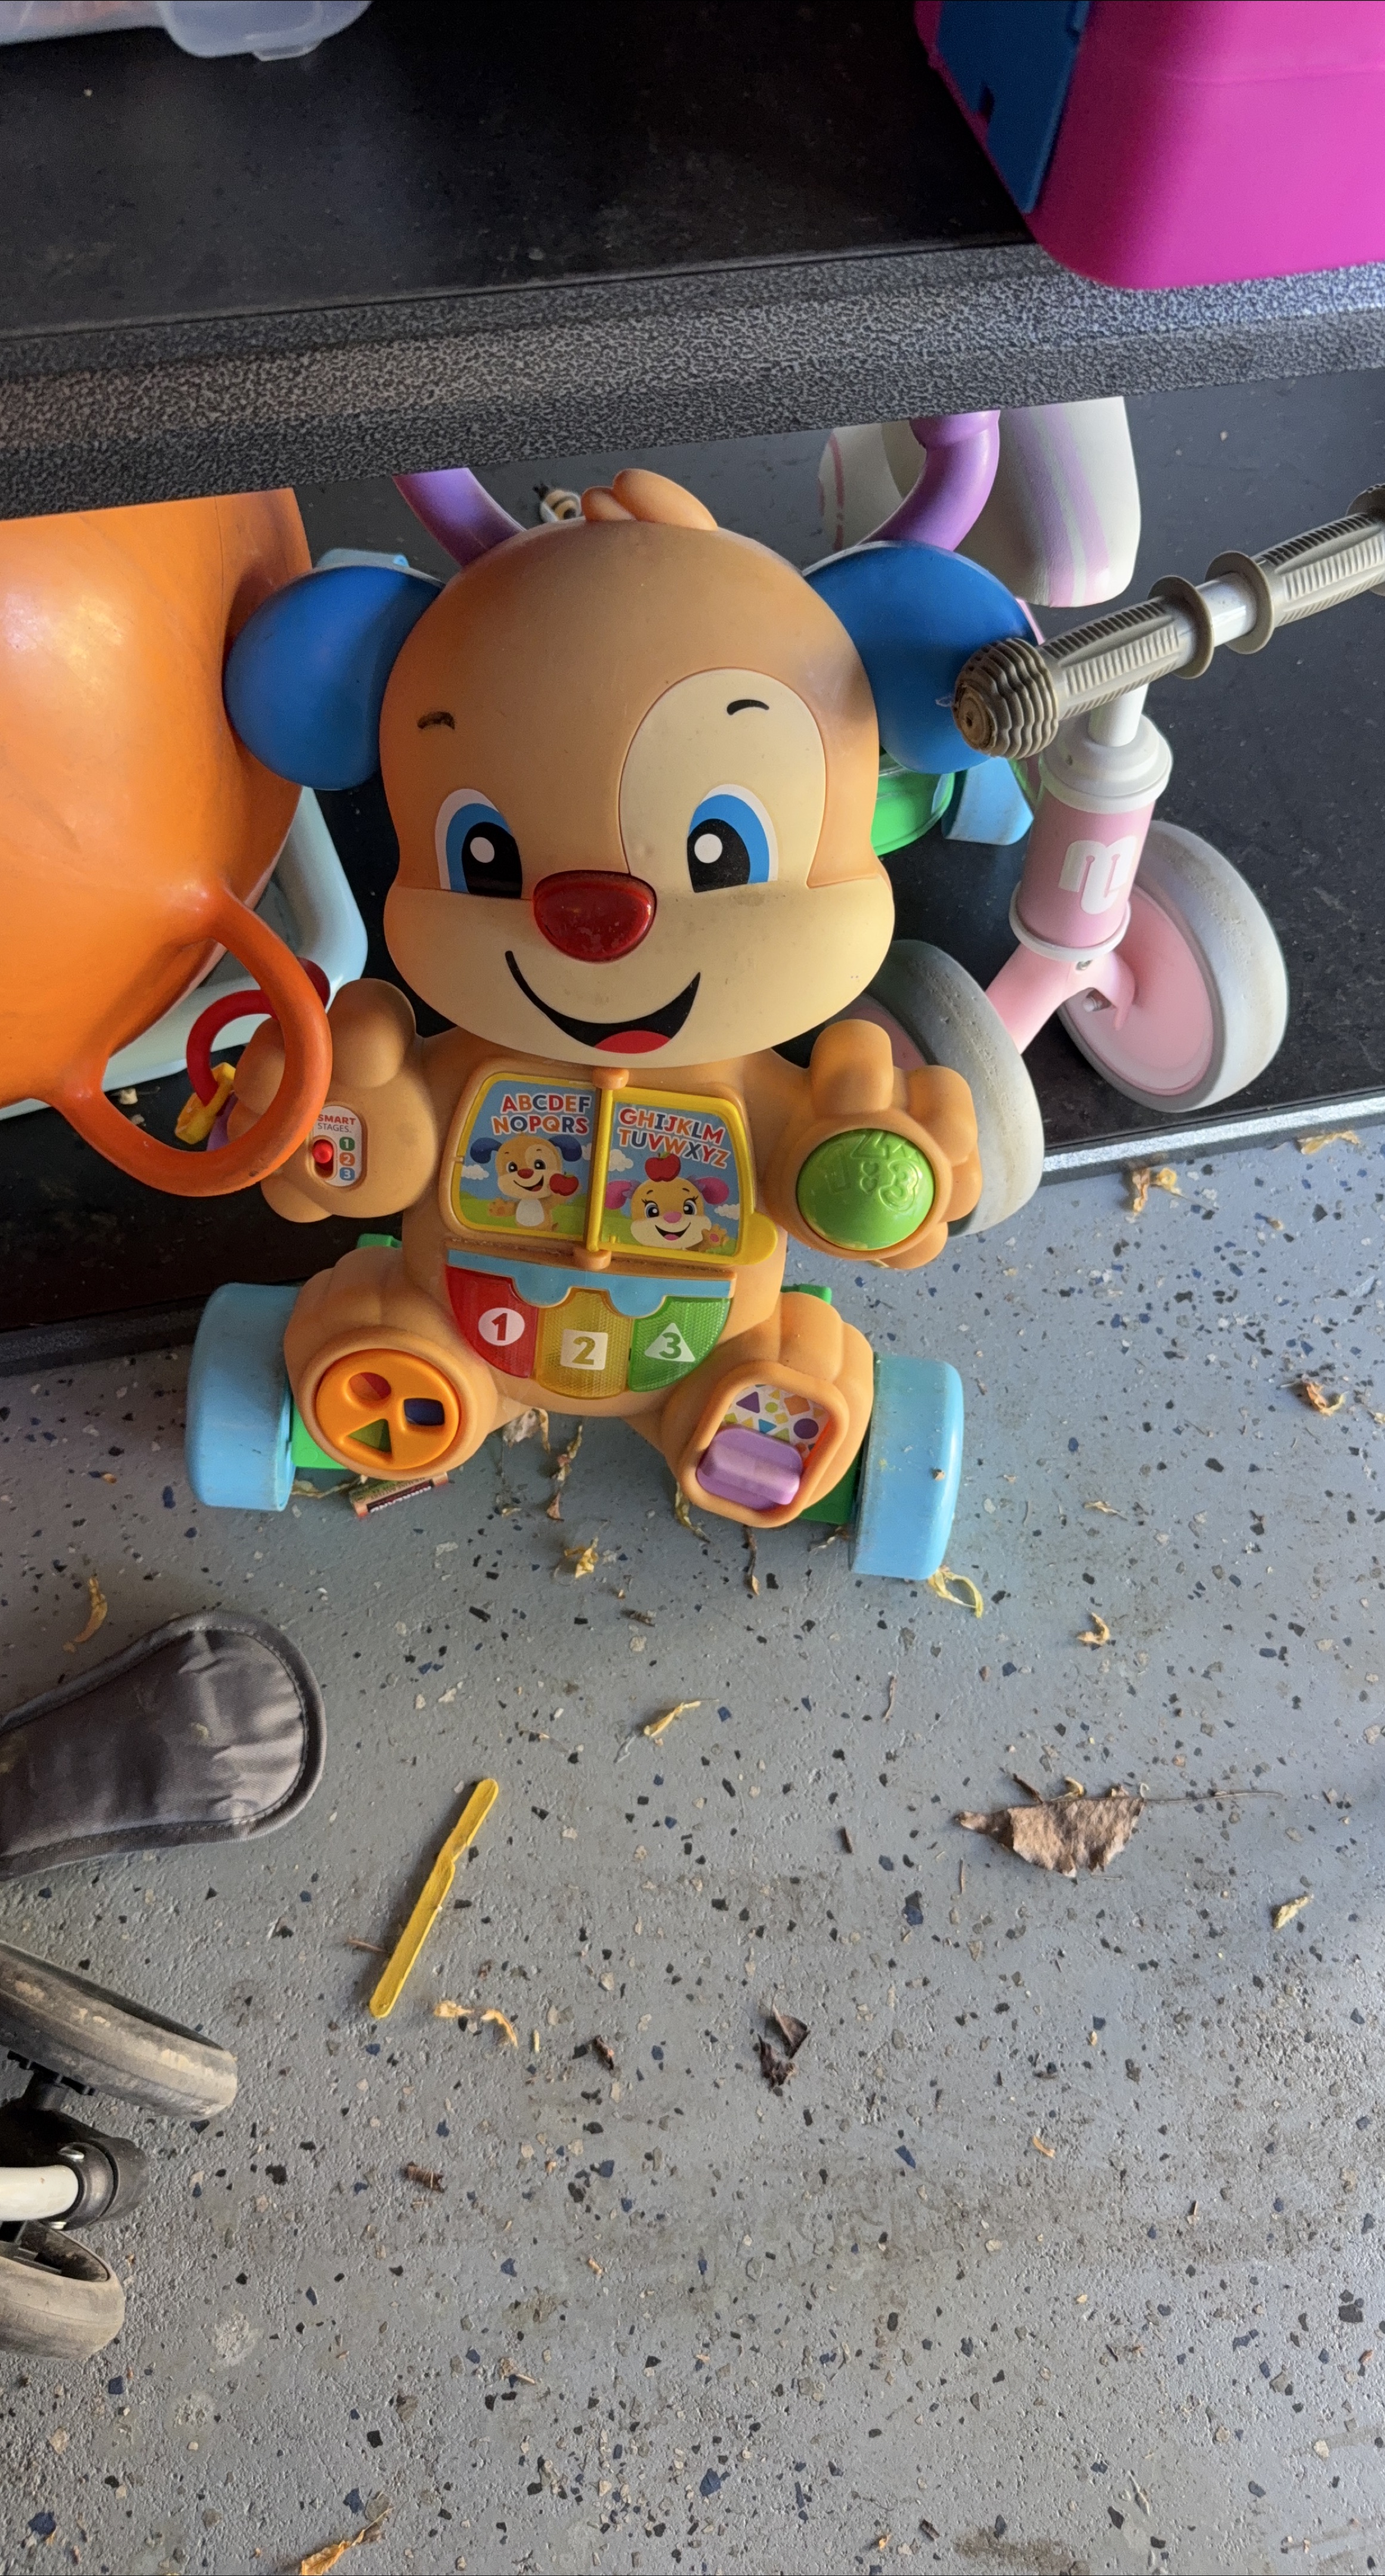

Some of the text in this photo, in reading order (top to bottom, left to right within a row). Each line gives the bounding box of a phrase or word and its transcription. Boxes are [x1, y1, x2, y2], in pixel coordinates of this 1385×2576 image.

[501, 1094, 591, 1113] ABCDEF
[318, 1114, 355, 1125] SMART
[492, 1115, 589, 1135] NOPQRS
[619, 1108, 724, 1144] GHIJKLM
[343, 1138, 349, 1148] 1
[619, 1128, 730, 1168] TUVWXYZ
[343, 1154, 351, 1165] 2
[343, 1169, 351, 1179] 3
[491, 1312, 508, 1340] 1
[571, 1336, 596, 1365] 2
[659, 1332, 682, 1359] 3
